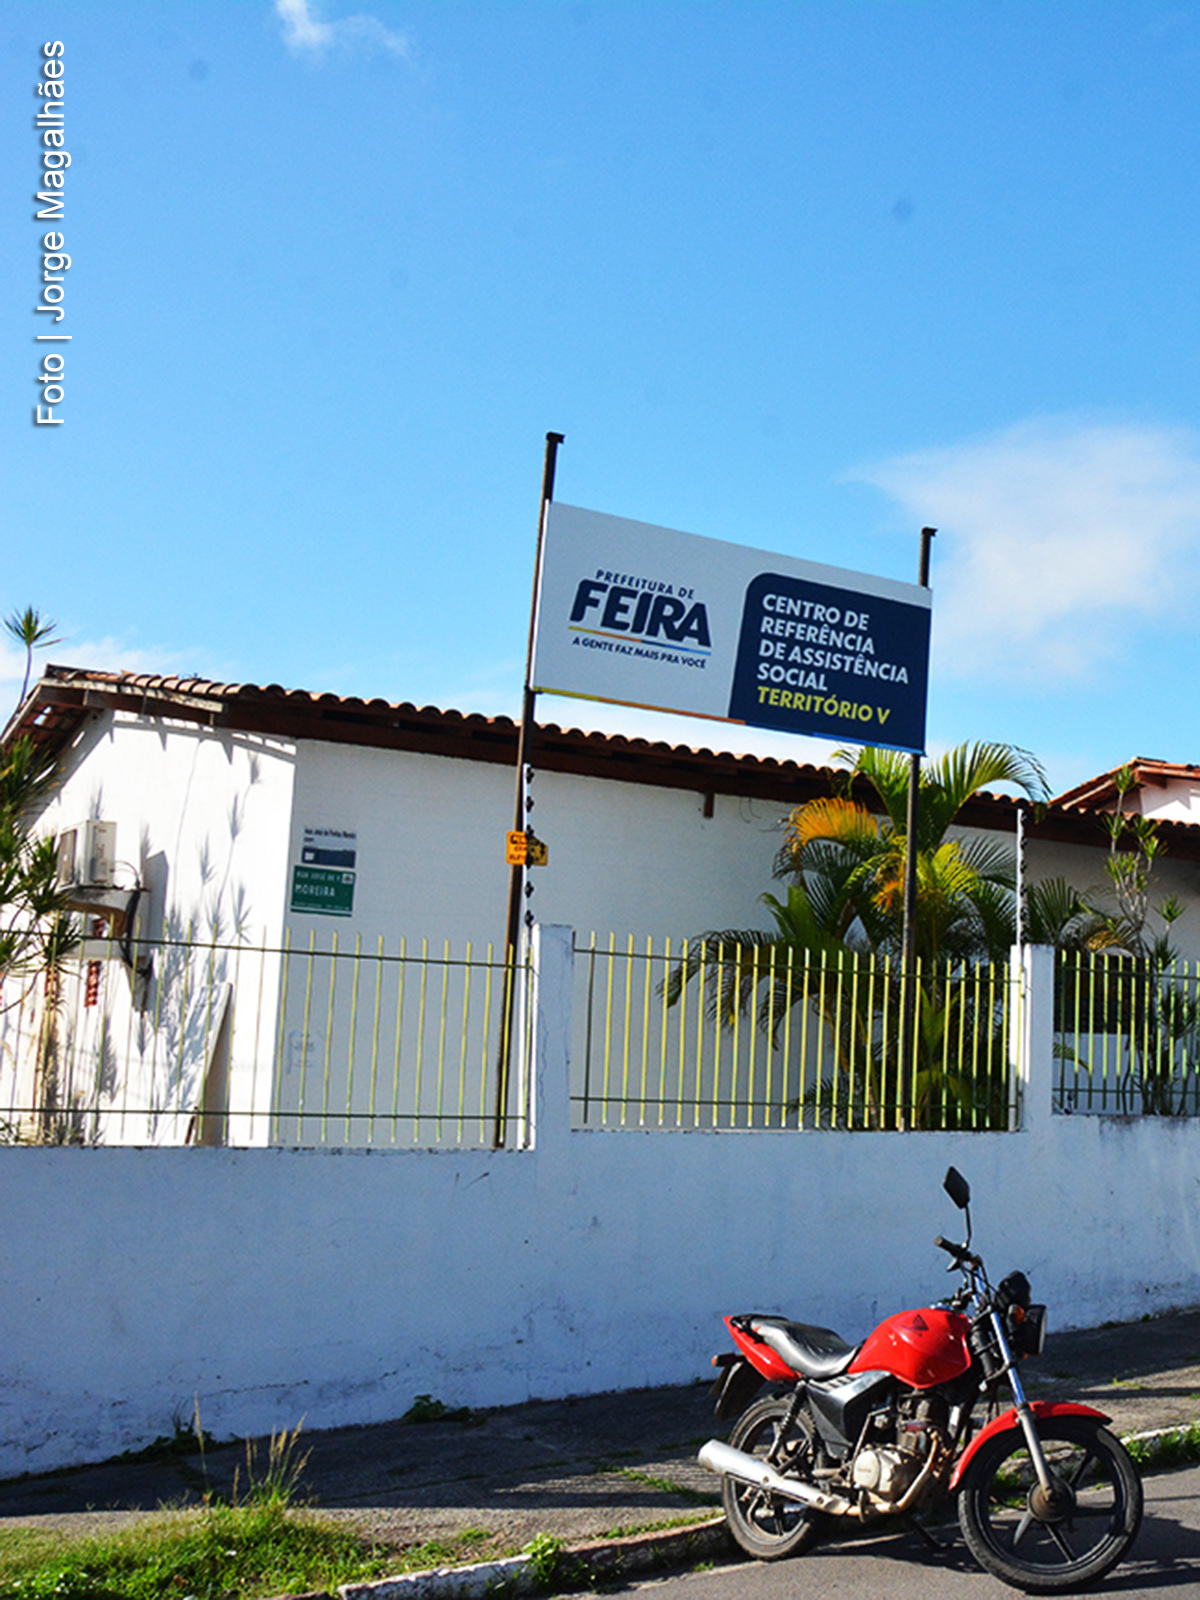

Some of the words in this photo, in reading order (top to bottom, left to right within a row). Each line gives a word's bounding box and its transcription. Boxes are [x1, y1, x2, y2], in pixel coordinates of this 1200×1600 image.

[595, 569, 674, 595] PREFEITURA
[677, 587, 695, 600] DE
[569, 579, 712, 648] FEIRA
[762, 593, 841, 624] CENTRO
[843, 610, 870, 631] DE
[572, 636, 580, 646] A
[581, 637, 613, 652] GENTE
[614, 645, 634, 656] FAZ
[633, 648, 660, 661] MAIS
[660, 653, 680, 664] PRA
[760, 616, 875, 655] REFERÊNCIA
[756, 662, 828, 691] SOCIAL
[758, 638, 787, 660] DE
[787, 645, 909, 685] ASSISTÊNCIA
[757, 685, 873, 722] TERRITÓRIO
[876, 706, 891, 725] V
[295, 883, 336, 897] MOREIRA
